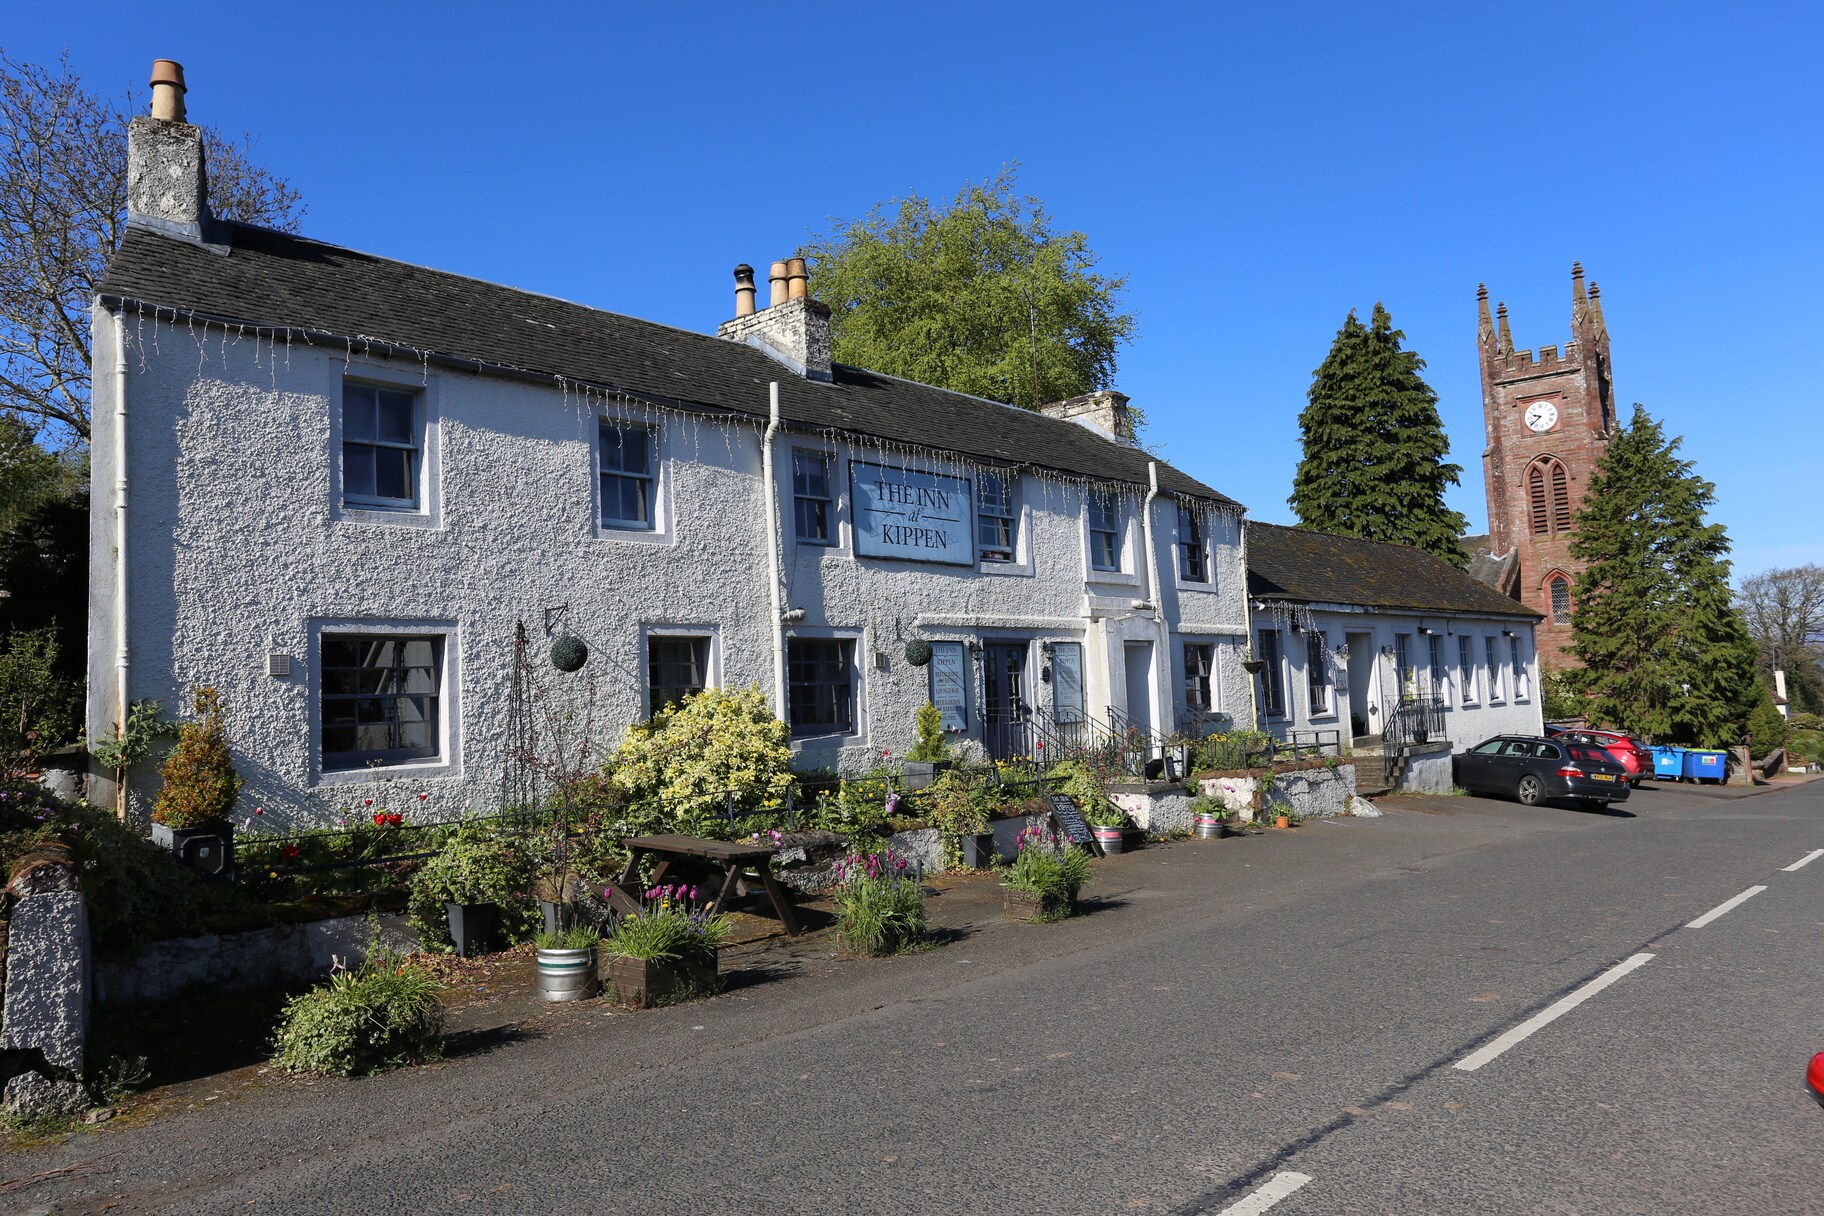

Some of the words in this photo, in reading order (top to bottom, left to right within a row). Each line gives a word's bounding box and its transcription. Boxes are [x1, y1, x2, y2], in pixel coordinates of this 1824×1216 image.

[874, 481, 914, 505] THE
[917, 487, 950, 510] INN
[908, 507, 921, 522] at
[882, 523, 947, 549] KIPPEN
